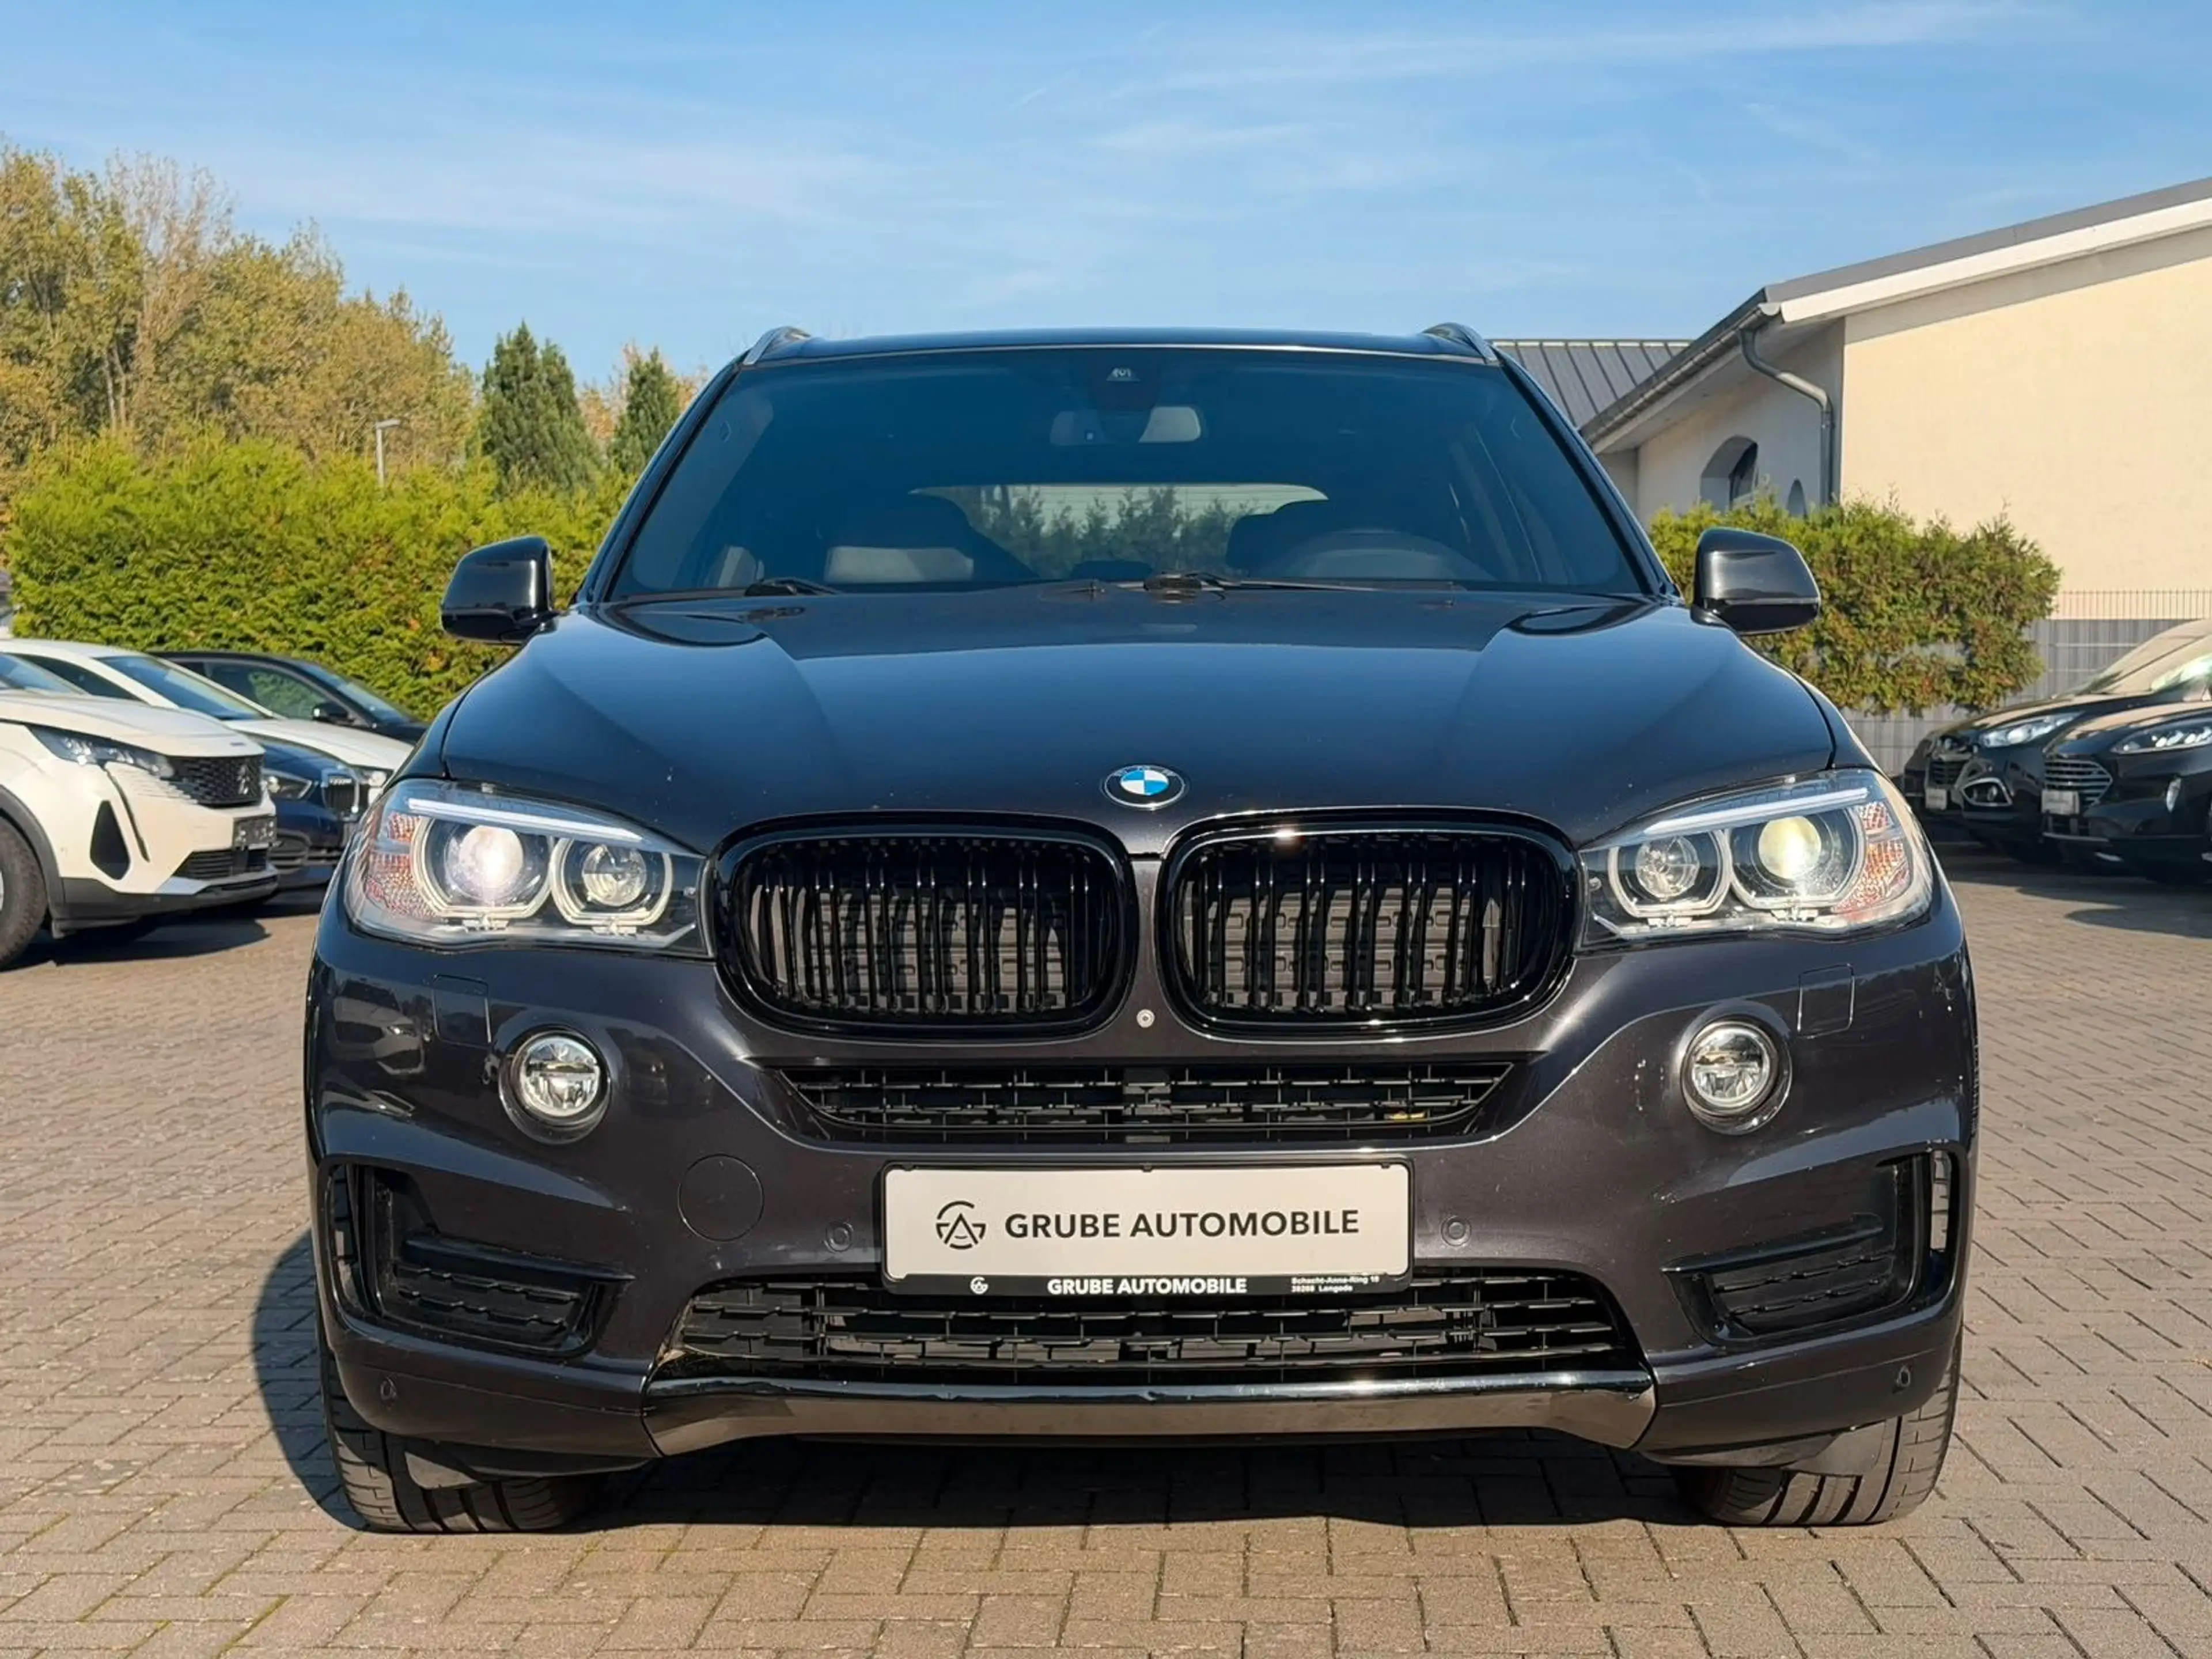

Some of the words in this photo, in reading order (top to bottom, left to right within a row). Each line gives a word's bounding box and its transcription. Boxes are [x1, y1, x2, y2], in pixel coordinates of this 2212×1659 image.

[1005, 1213, 1120, 1238] GRUBE
[1130, 1210, 1359, 1237] AUTOMOBILE
[1047, 1278, 1113, 1295] GRUBE
[1116, 1278, 1247, 1294] AUTOMOBILE
